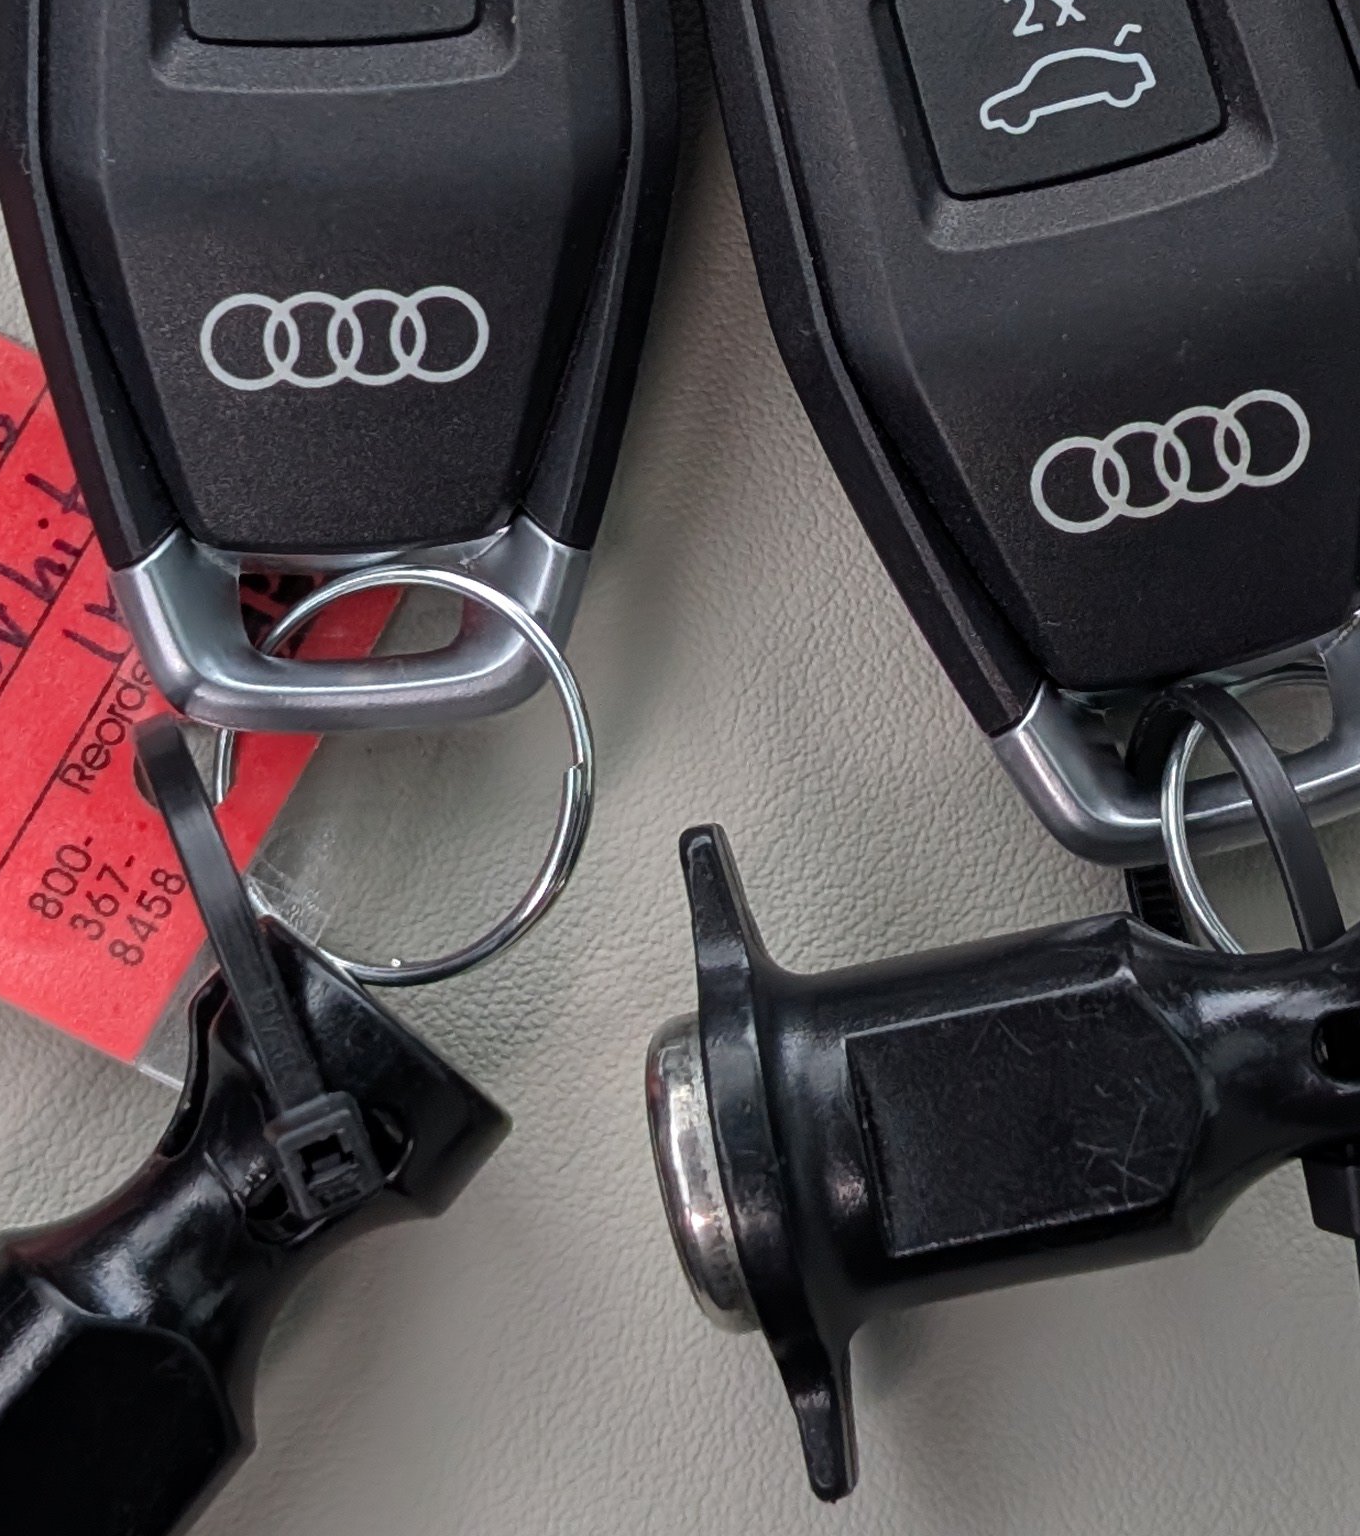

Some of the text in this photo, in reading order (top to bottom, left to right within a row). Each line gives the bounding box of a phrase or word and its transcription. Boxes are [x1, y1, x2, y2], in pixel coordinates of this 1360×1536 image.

[27, 835, 95, 920] 800-
[69, 855, 139, 941] 367-
[109, 868, 186, 967] 8458
